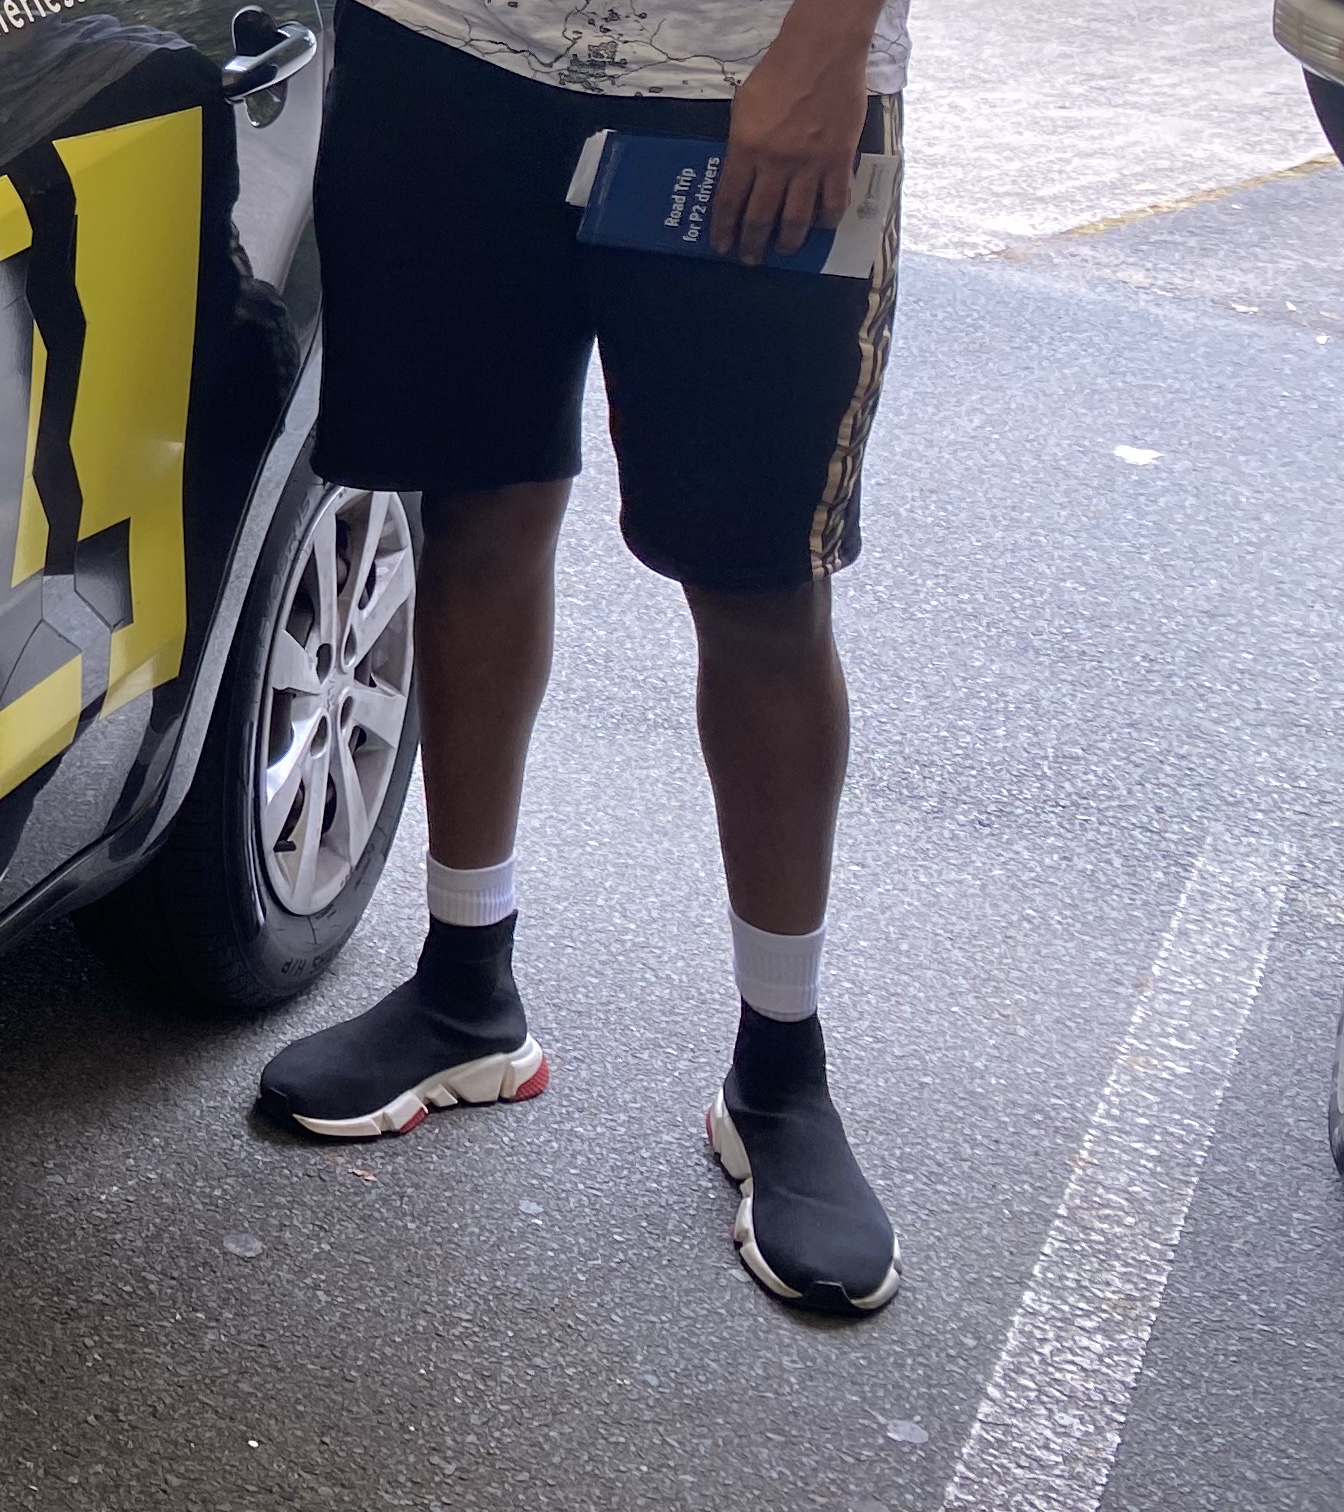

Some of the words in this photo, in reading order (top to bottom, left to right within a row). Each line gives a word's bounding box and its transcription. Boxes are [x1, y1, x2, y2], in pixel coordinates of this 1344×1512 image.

[674, 168, 697, 191] Trip
[695, 157, 720, 202] drivers
[664, 195, 687, 227] Road
[689, 205, 706, 222] P2
[683, 223, 702, 242] for
